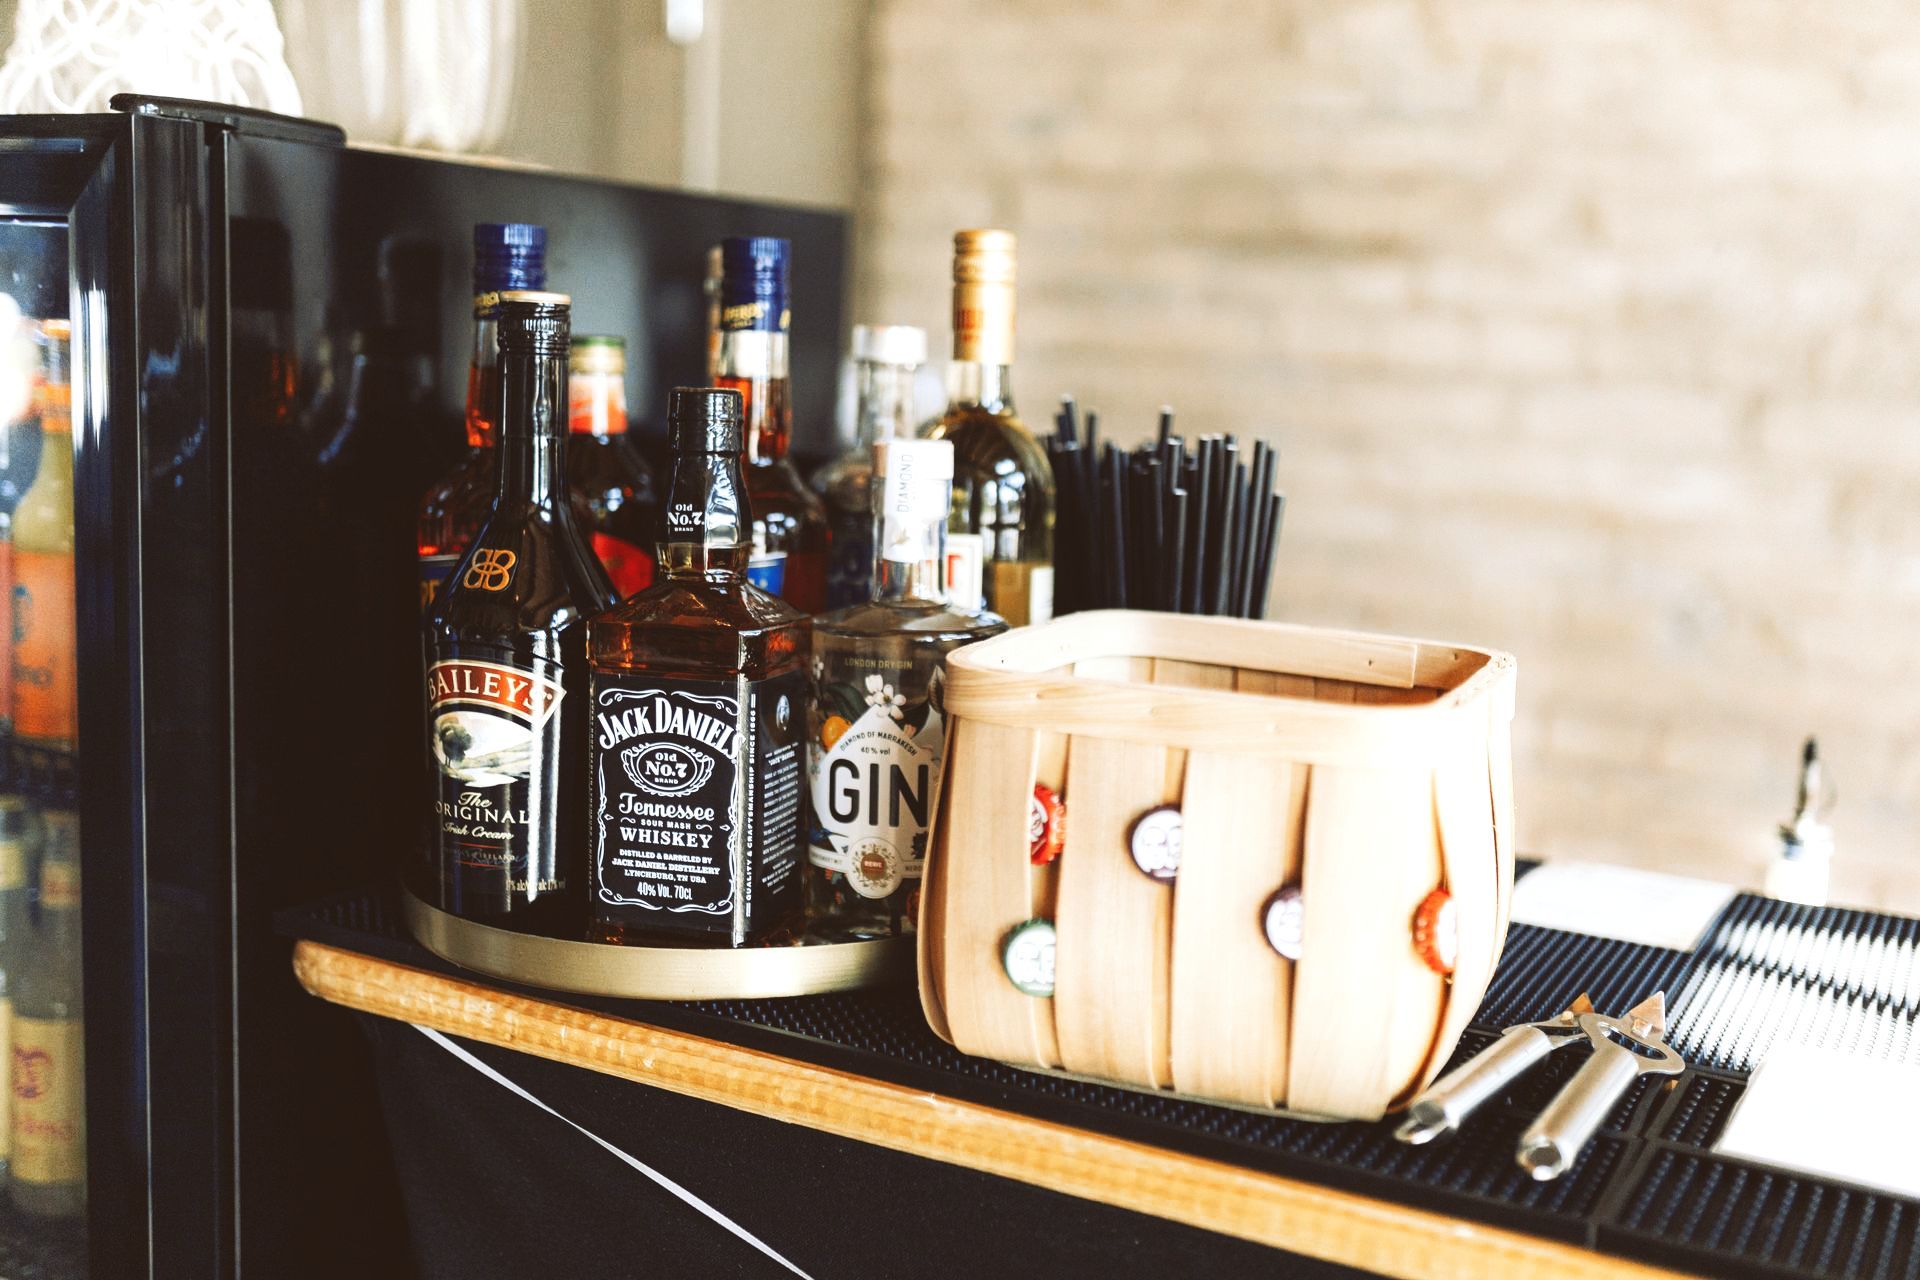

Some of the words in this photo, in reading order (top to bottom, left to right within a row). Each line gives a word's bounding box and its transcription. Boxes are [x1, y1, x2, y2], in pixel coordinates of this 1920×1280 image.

[897, 454, 914, 513] DIAMOND
[675, 504, 693, 512] Old
[844, 658, 877, 668] LONDON
[428, 669, 547, 708] BAILEYS
[597, 705, 654, 750] JACK
[840, 732, 866, 752] DIAMOND
[877, 731, 918, 757] MARRAKESH
[880, 747, 891, 755] vol
[655, 752, 678, 762] Old
[645, 761, 688, 778] No.7
[458, 791, 492, 808] The
[829, 758, 929, 828] GIN
[618, 792, 715, 821] Tennessee
[442, 821, 469, 836] Irish
[472, 825, 515, 840] Cream
[640, 818, 664, 828] SOUR
[667, 821, 691, 830] MASH
[620, 826, 713, 849] WHISKEY
[619, 849, 656, 859] DISTILLED
[663, 852, 701, 863] BARRELED
[611, 858, 634, 867] JACK
[635, 860, 668, 871] DANIEL
[668, 863, 721, 875] DISTILLERY
[624, 869, 676, 881] LYNCHBURG,
[677, 874, 689, 882] TN
[690, 876, 707, 884] USA
[745, 859, 753, 901] QUALITY
[637, 881, 656, 897] 40%
